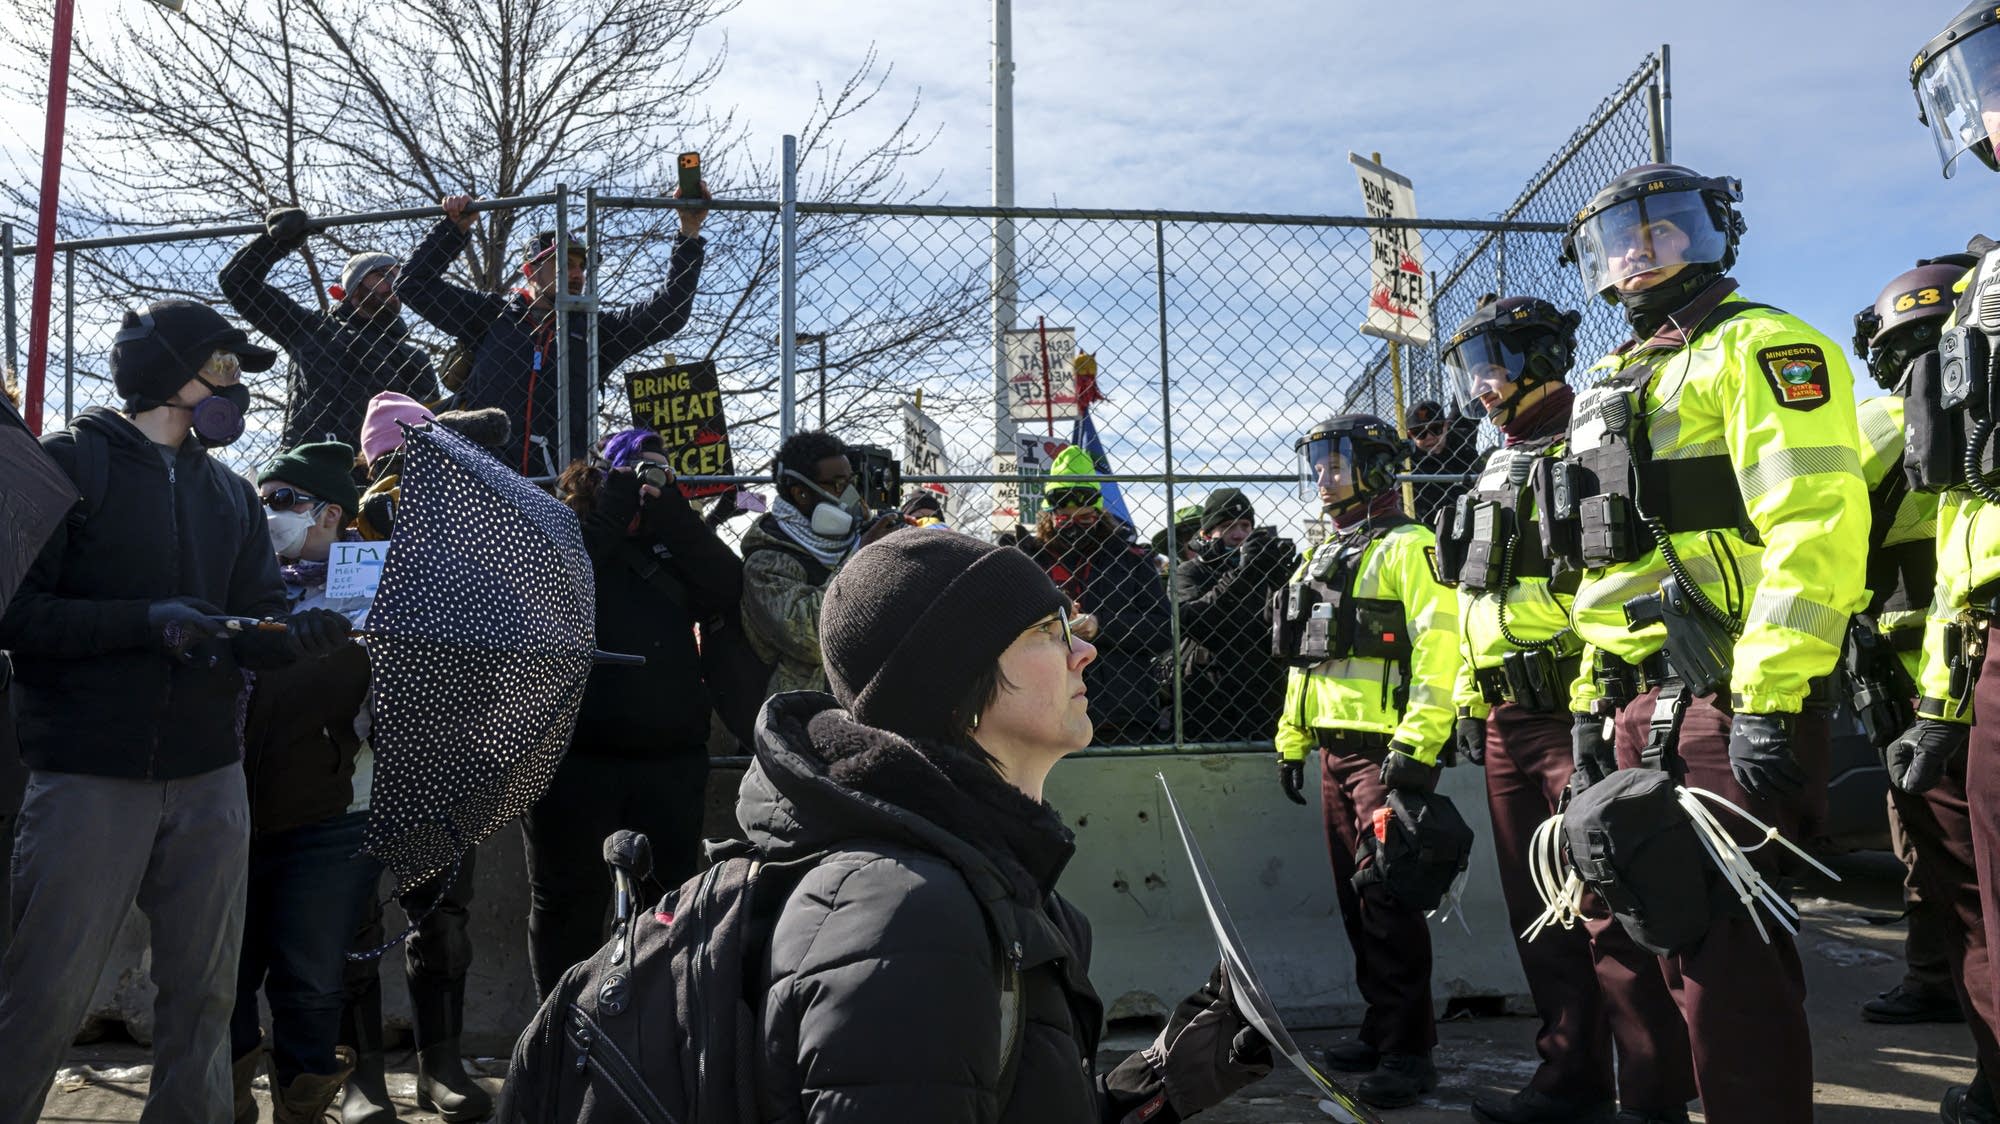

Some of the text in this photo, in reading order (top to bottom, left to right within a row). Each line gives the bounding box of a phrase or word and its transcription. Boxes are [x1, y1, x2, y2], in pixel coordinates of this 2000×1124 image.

[1361, 176, 1394, 211] BRING
[1391, 269, 1422, 310] ICE!
[1895, 288, 1941, 312] 63
[1765, 347, 1817, 360] MINNESOTA
[632, 372, 691, 399] BRING
[1791, 383, 1813, 391] STATE
[1791, 389, 1819, 397] PATROL
[634, 390, 719, 426] THE HEAT
[1579, 391, 1602, 414] STATE
[1573, 406, 1602, 432] TROOPE
[659, 425, 699, 449] ELT
[998, 489, 1018, 498] MEL
